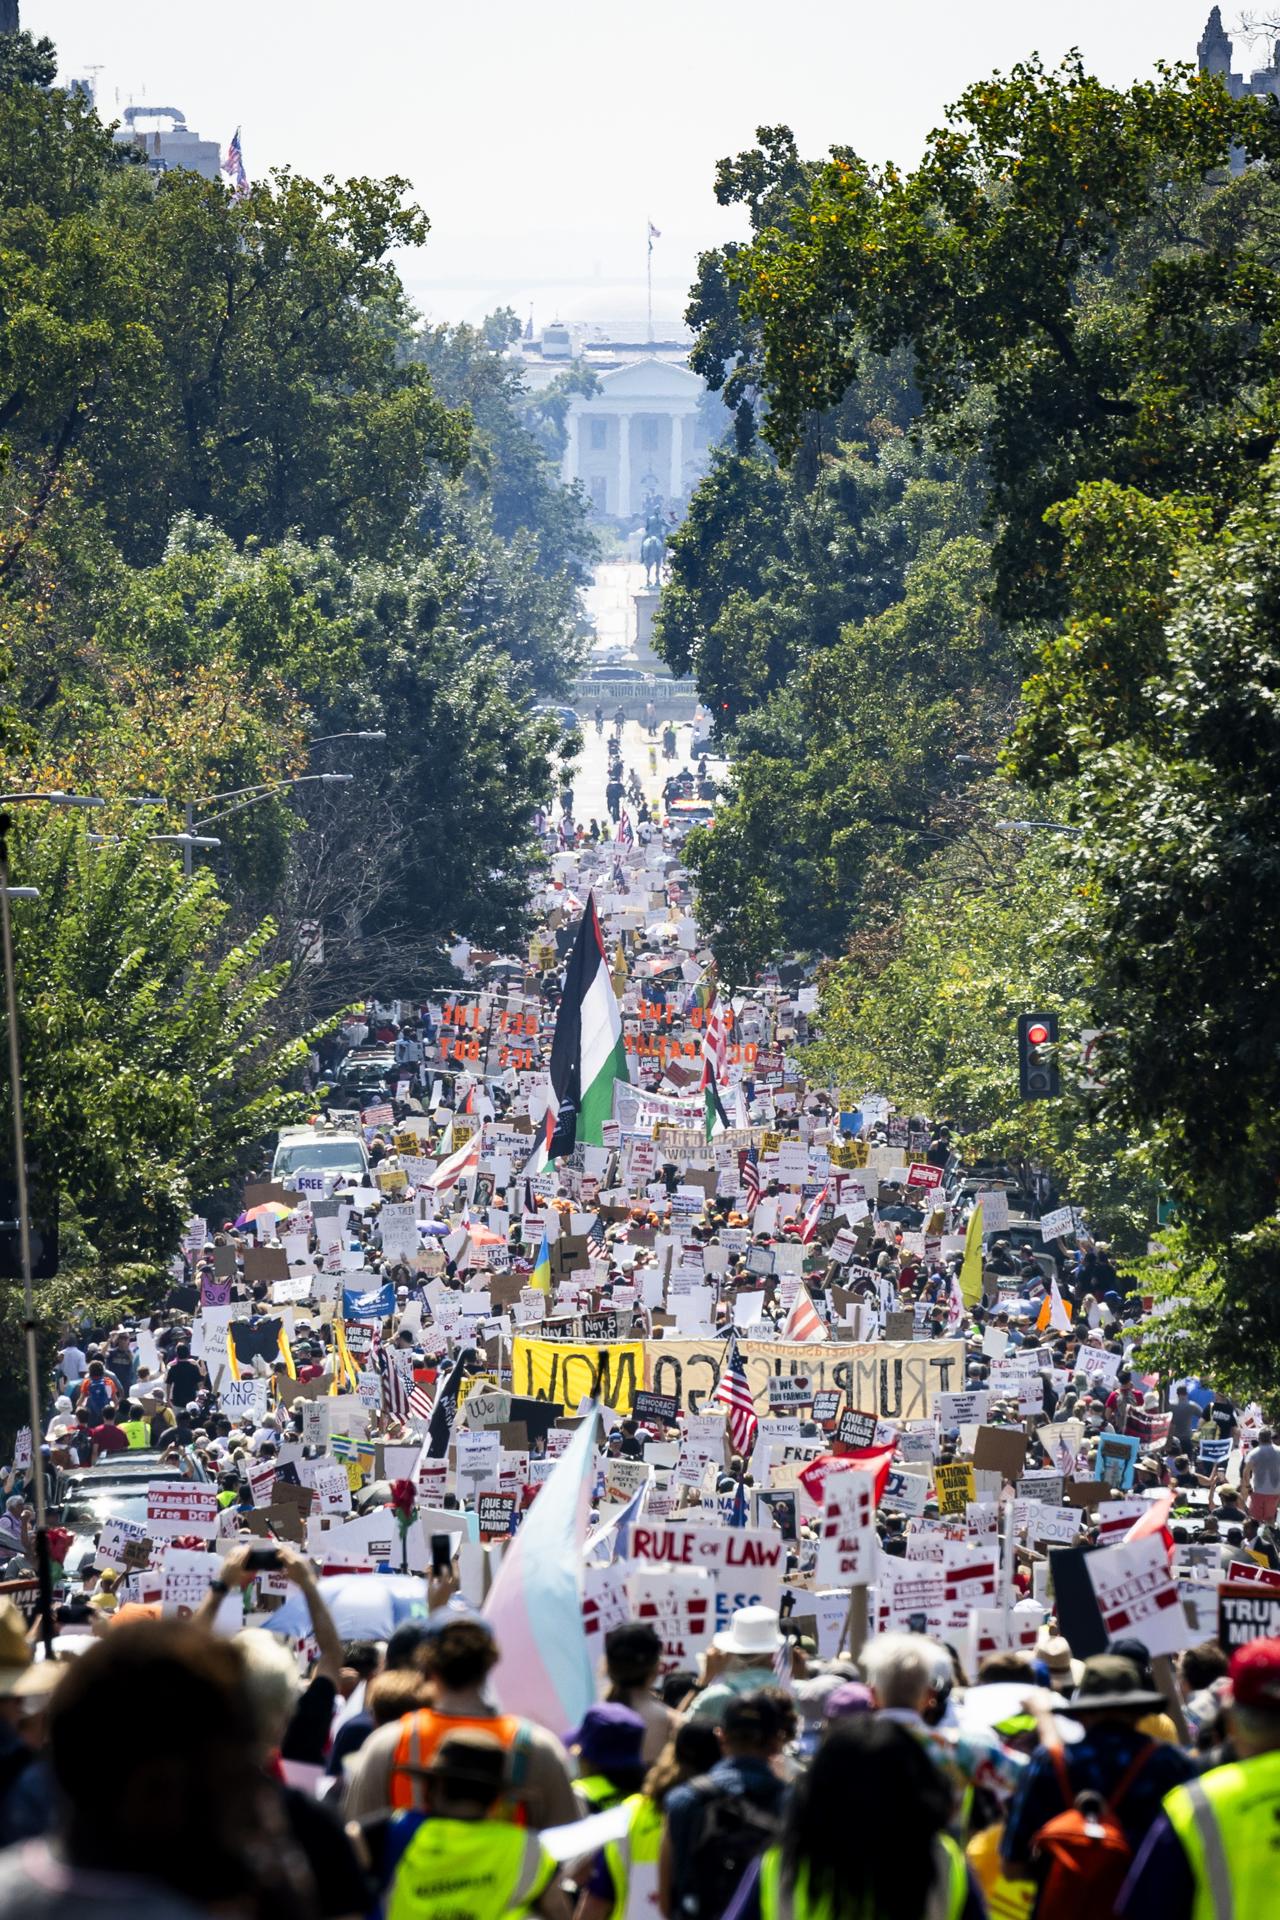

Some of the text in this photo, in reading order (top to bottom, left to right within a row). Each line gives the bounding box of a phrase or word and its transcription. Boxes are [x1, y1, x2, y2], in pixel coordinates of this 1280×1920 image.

[298, 1177, 324, 1191] FREE
[853, 1267, 880, 1281] MELT
[584, 1315, 617, 1333] Nov 5
[230, 1381, 254, 1394] NO
[779, 1380, 793, 1391] WE
[636, 1395, 677, 1413] DEMOCRACY
[782, 1391, 812, 1402] FARMERS
[468, 1398, 495, 1418] We
[840, 1422, 873, 1438] LARGUE
[839, 1432, 871, 1448] TRUMP
[784, 1446, 822, 1461] FREE
[935, 1464, 972, 1479] NATIONAL
[942, 1476, 968, 1489] GUARD
[149, 1491, 216, 1506] We are all DC
[502, 1498, 514, 1511] SE
[153, 1508, 212, 1522] Free DC!
[479, 1509, 512, 1521] LARGUE
[1029, 1504, 1049, 1520] DC
[479, 1520, 510, 1532] TRUMP
[1027, 1519, 1077, 1539] PROUD
[632, 1528, 781, 1567] RULE OF LAW
